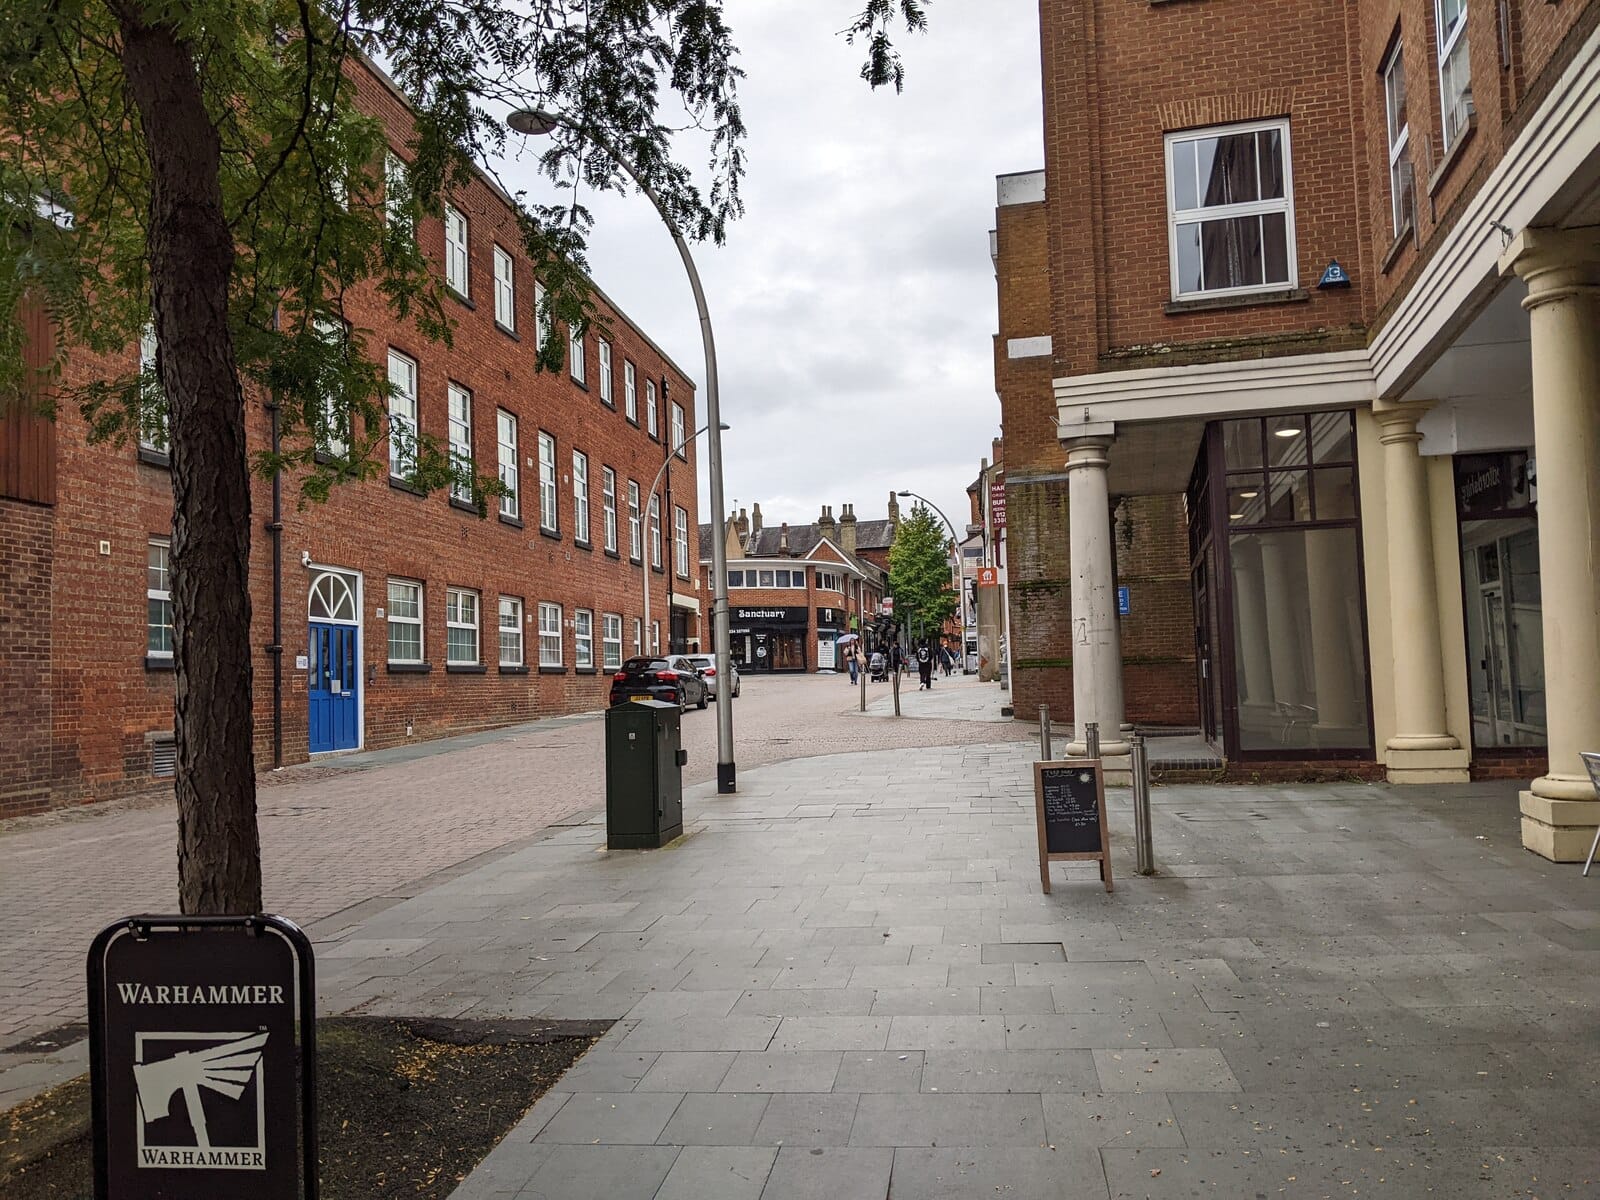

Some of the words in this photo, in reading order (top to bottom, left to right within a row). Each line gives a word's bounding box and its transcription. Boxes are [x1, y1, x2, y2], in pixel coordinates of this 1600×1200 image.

[738, 610, 785, 618] Sanctuary
[117, 983, 285, 1005] WARHAMMER
[141, 1148, 263, 1166] WARHAMMER
